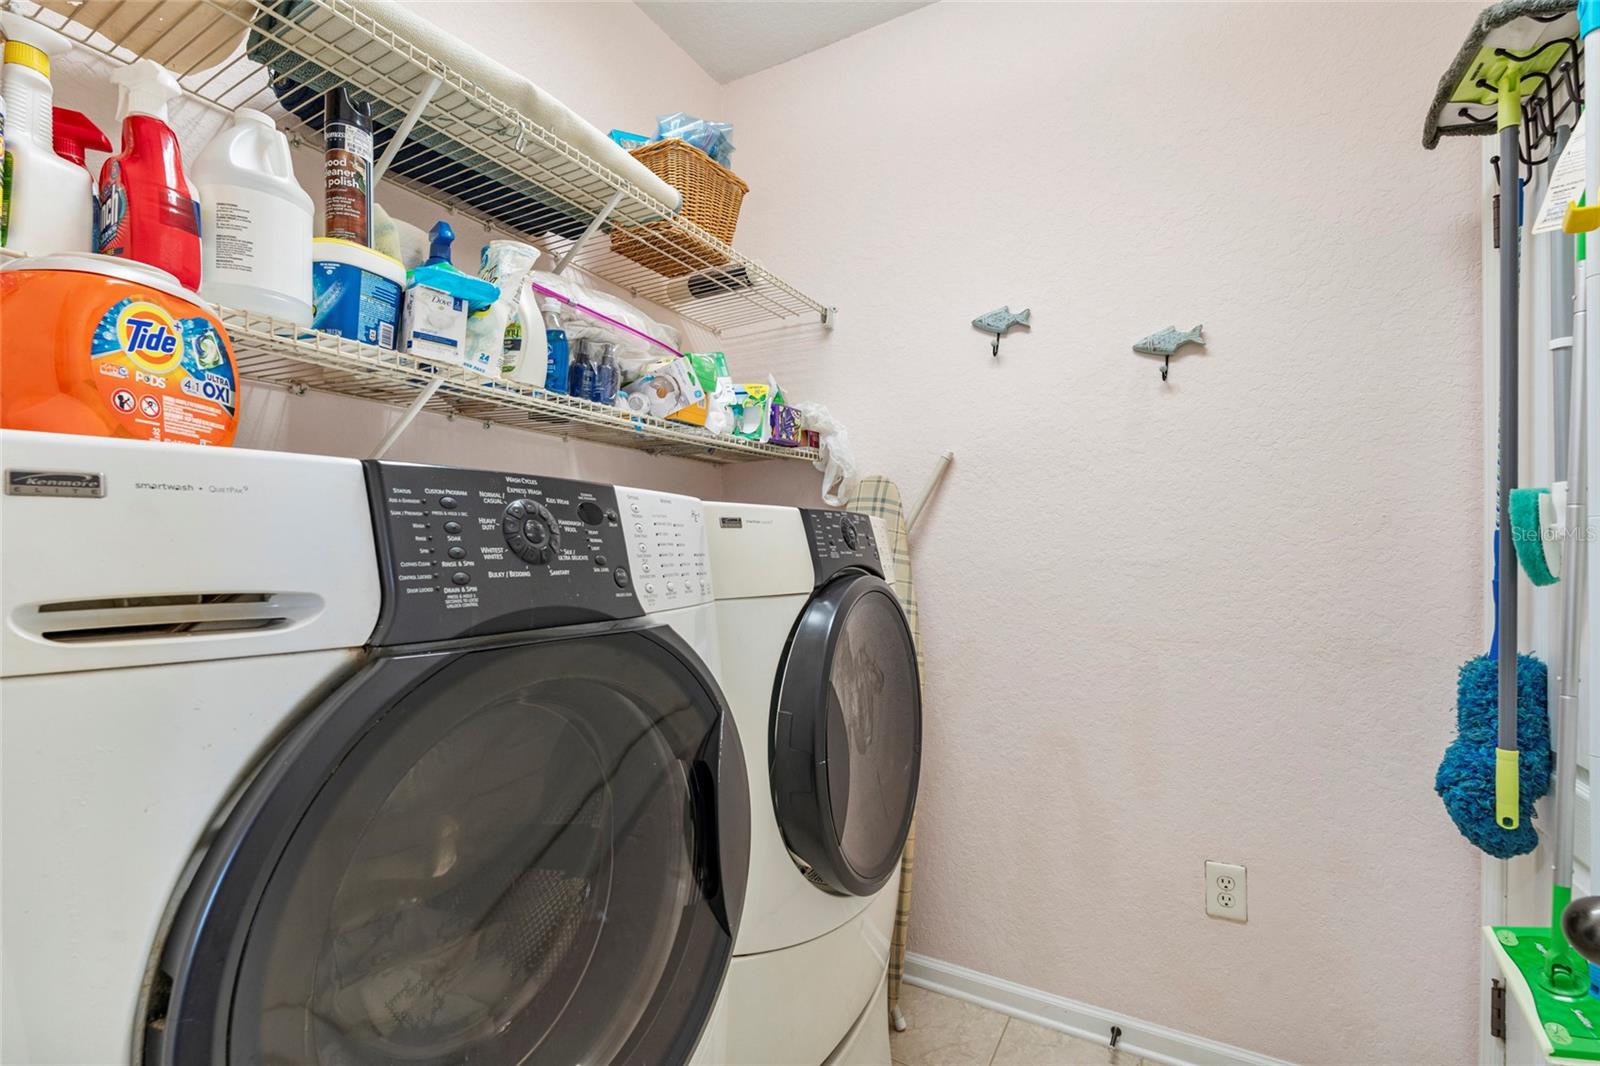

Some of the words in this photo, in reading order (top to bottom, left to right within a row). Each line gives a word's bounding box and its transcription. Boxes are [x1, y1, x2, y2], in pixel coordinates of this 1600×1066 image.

[328, 176, 360, 189] polish
[432, 296, 452, 306] Dove
[126, 318, 177, 353] Tide
[479, 352, 490, 362] 24
[135, 370, 167, 389] PODS
[206, 373, 229, 387] ULTRA
[203, 381, 230, 404] OXI
[26, 477, 99, 488] Kenmore
[135, 482, 194, 492] smartwash
[392, 487, 412, 495] STATUS
[507, 486, 527, 494] EXPRESS
[478, 517, 496, 525] HEAVY
[509, 570, 531, 578] BEDDING
